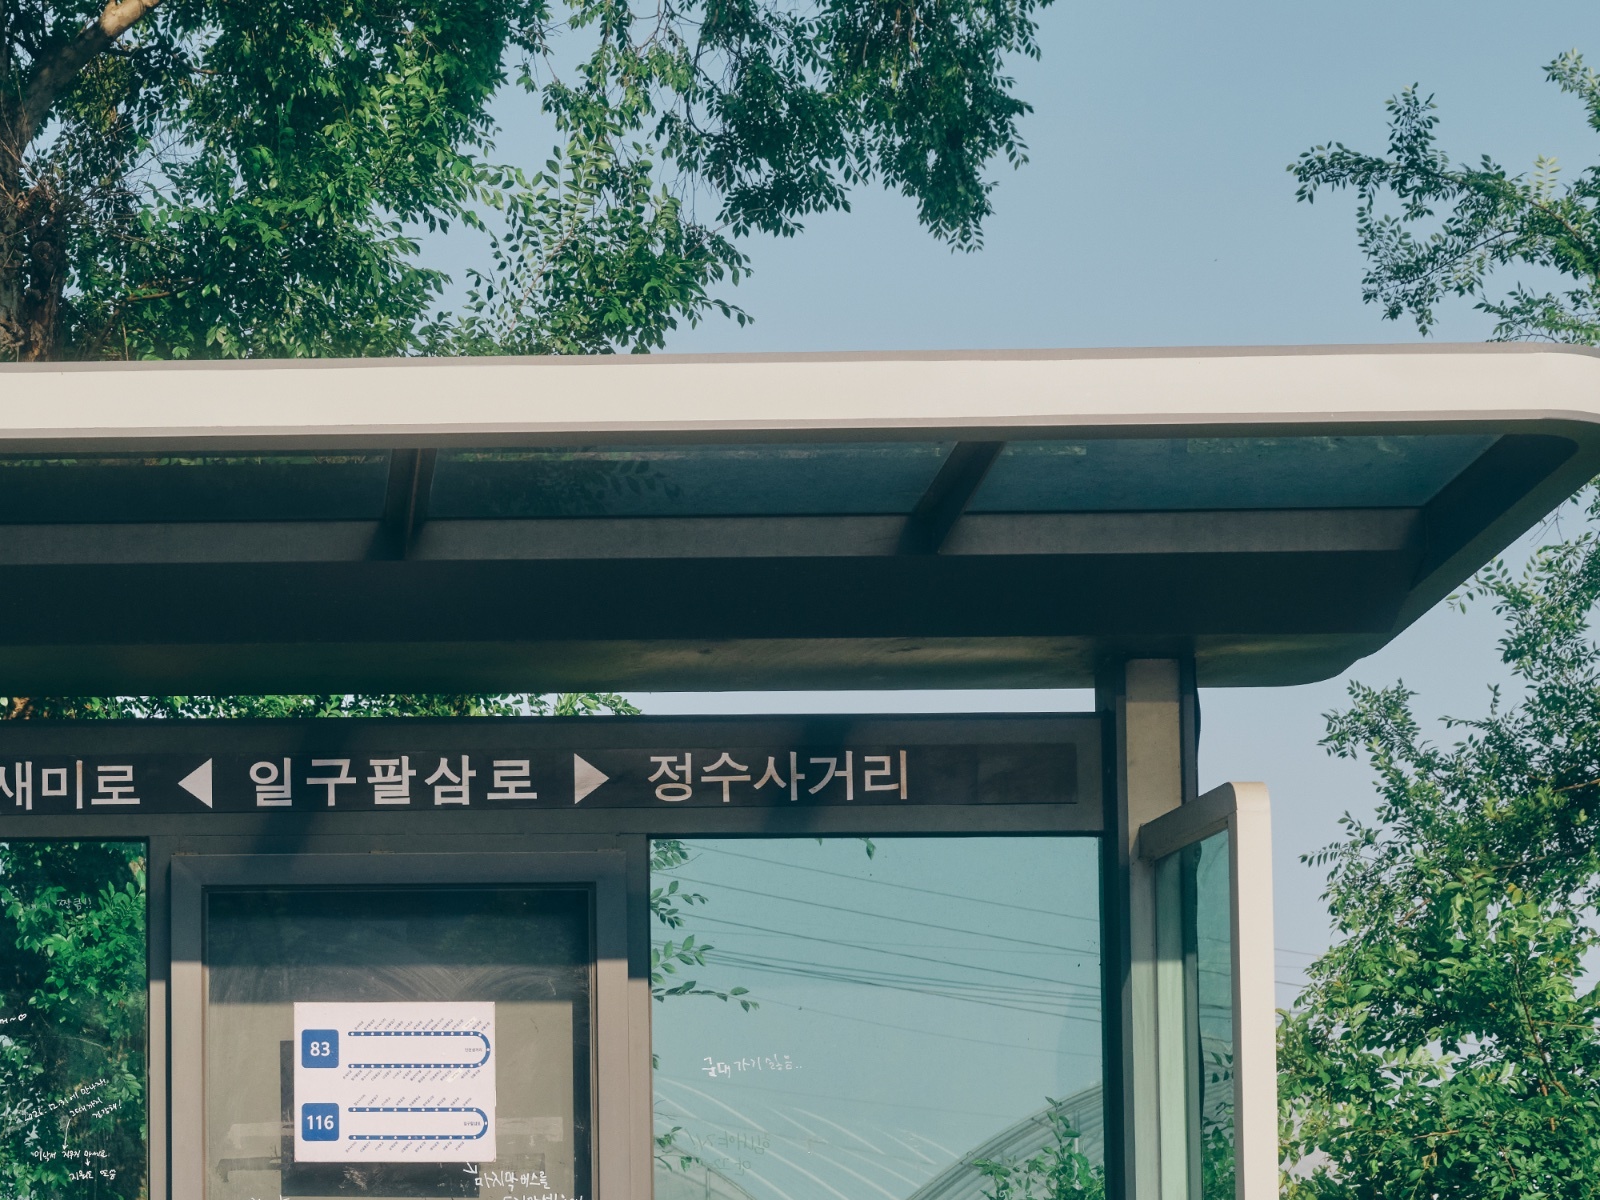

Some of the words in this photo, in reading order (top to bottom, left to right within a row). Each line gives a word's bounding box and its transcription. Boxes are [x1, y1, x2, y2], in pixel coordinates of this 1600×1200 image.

[249, 755, 538, 807] 일구팔삼로
[647, 749, 908, 802] 정수사거리
[310, 1040, 331, 1057] 83
[734, 1056, 762, 1071] 가기
[307, 1114, 334, 1131] 116
[475, 1171, 518, 1192] 마지막
[520, 1171, 551, 1190] 버스를
